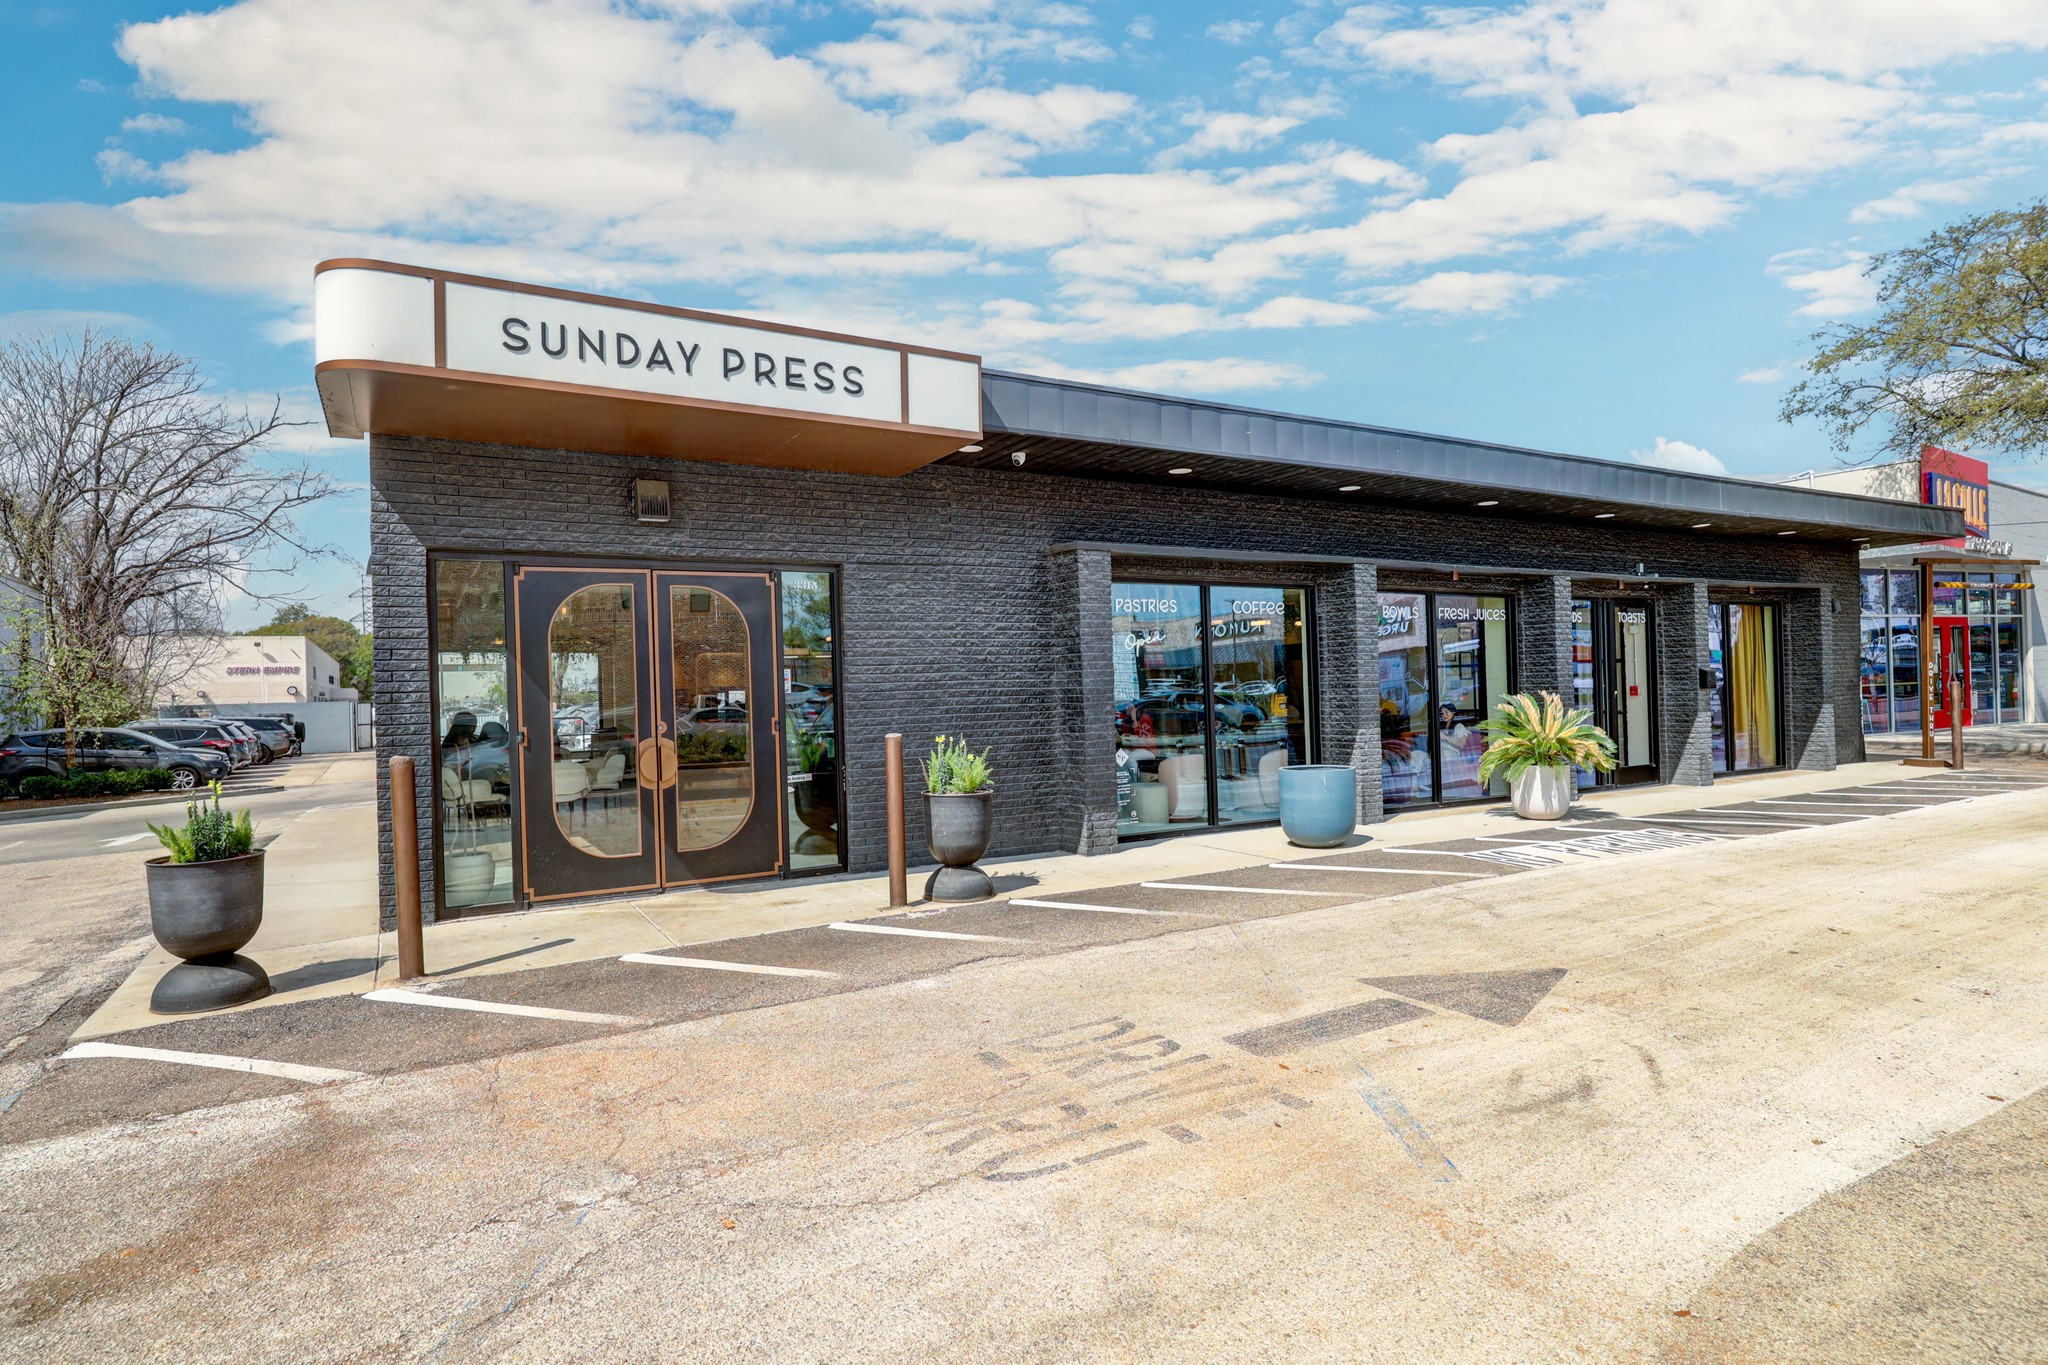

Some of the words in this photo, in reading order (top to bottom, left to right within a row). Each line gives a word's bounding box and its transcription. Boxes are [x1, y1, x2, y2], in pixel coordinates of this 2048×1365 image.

[501, 316, 701, 375] SUNDAY
[723, 347, 865, 397] PRESS
[1382, 605, 1419, 619] BOWLS
[1124, 629, 1168, 657] Open
[226, 666, 261, 676] STERN
[262, 666, 300, 675] EMPIRE
